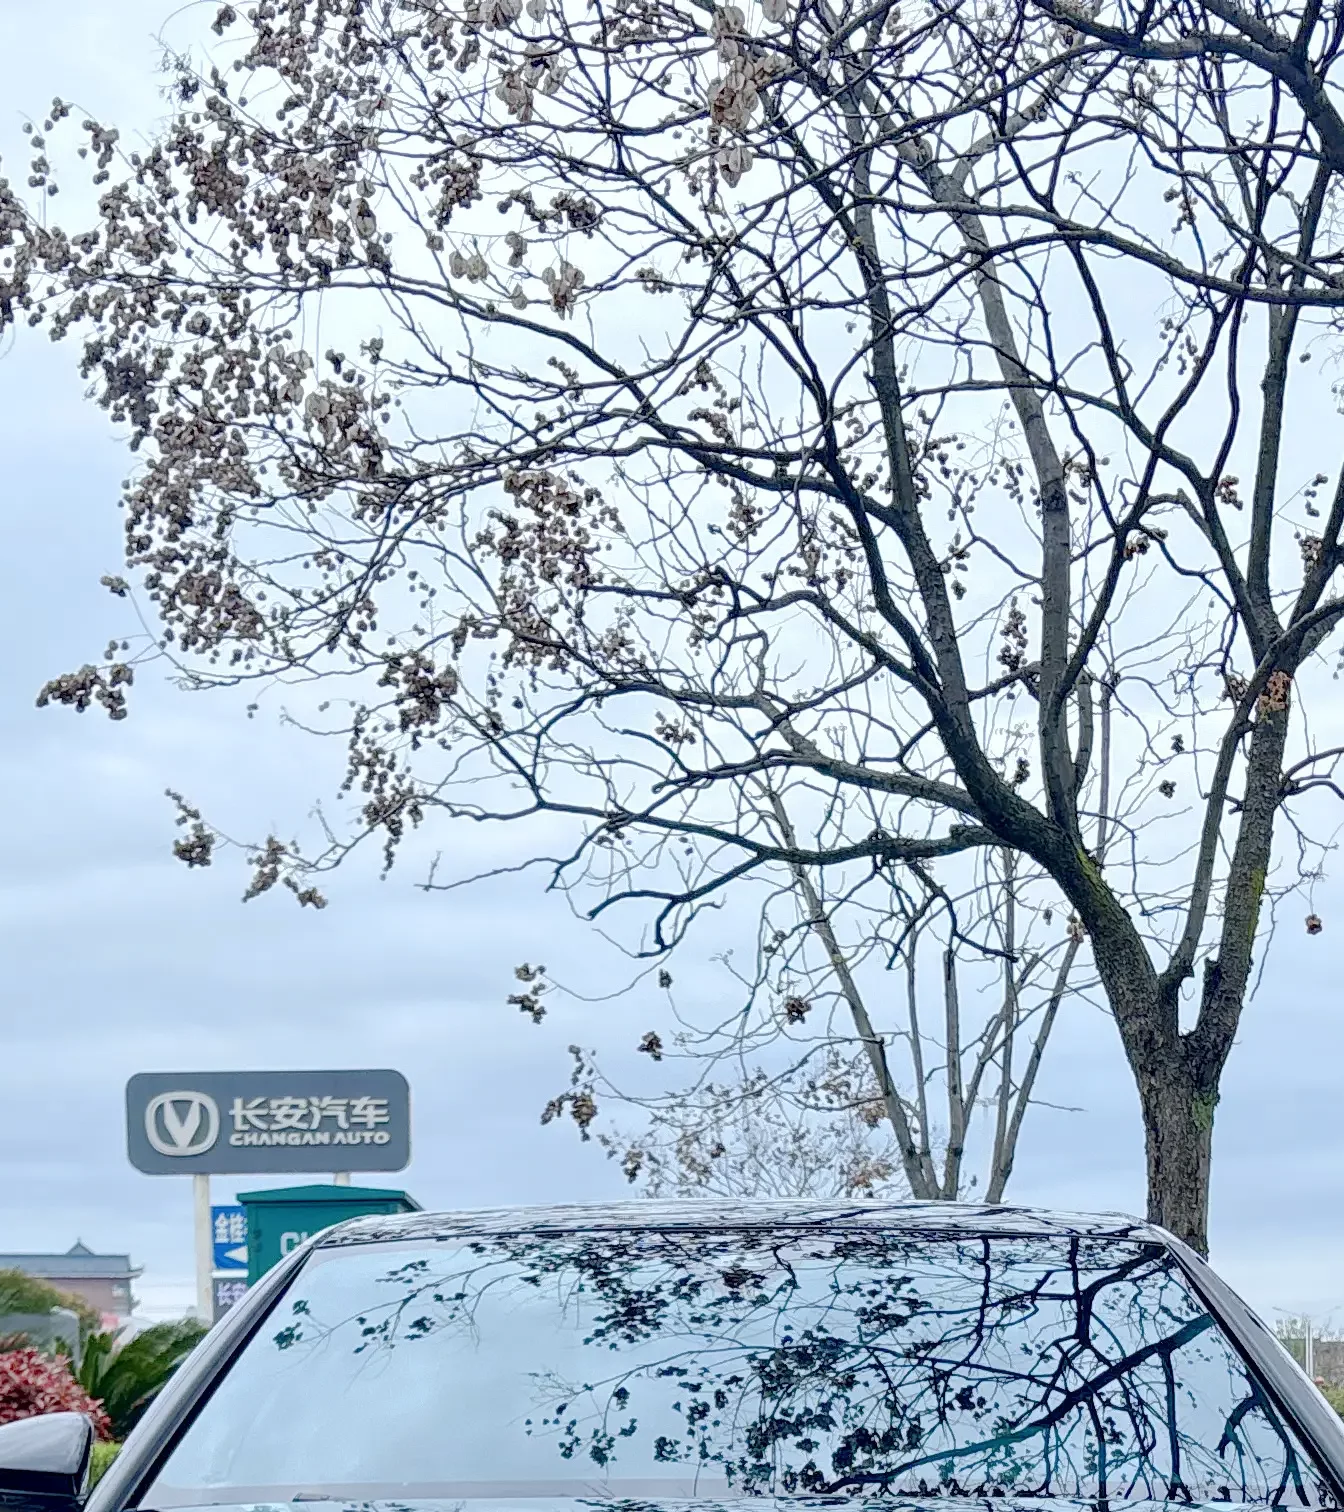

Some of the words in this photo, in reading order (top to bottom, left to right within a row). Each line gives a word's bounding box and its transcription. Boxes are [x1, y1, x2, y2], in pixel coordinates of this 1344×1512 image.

[229, 1095, 390, 1132] 长安汽车
[228, 1131, 330, 1147] CHANGAN
[332, 1131, 392, 1145] AUTO
